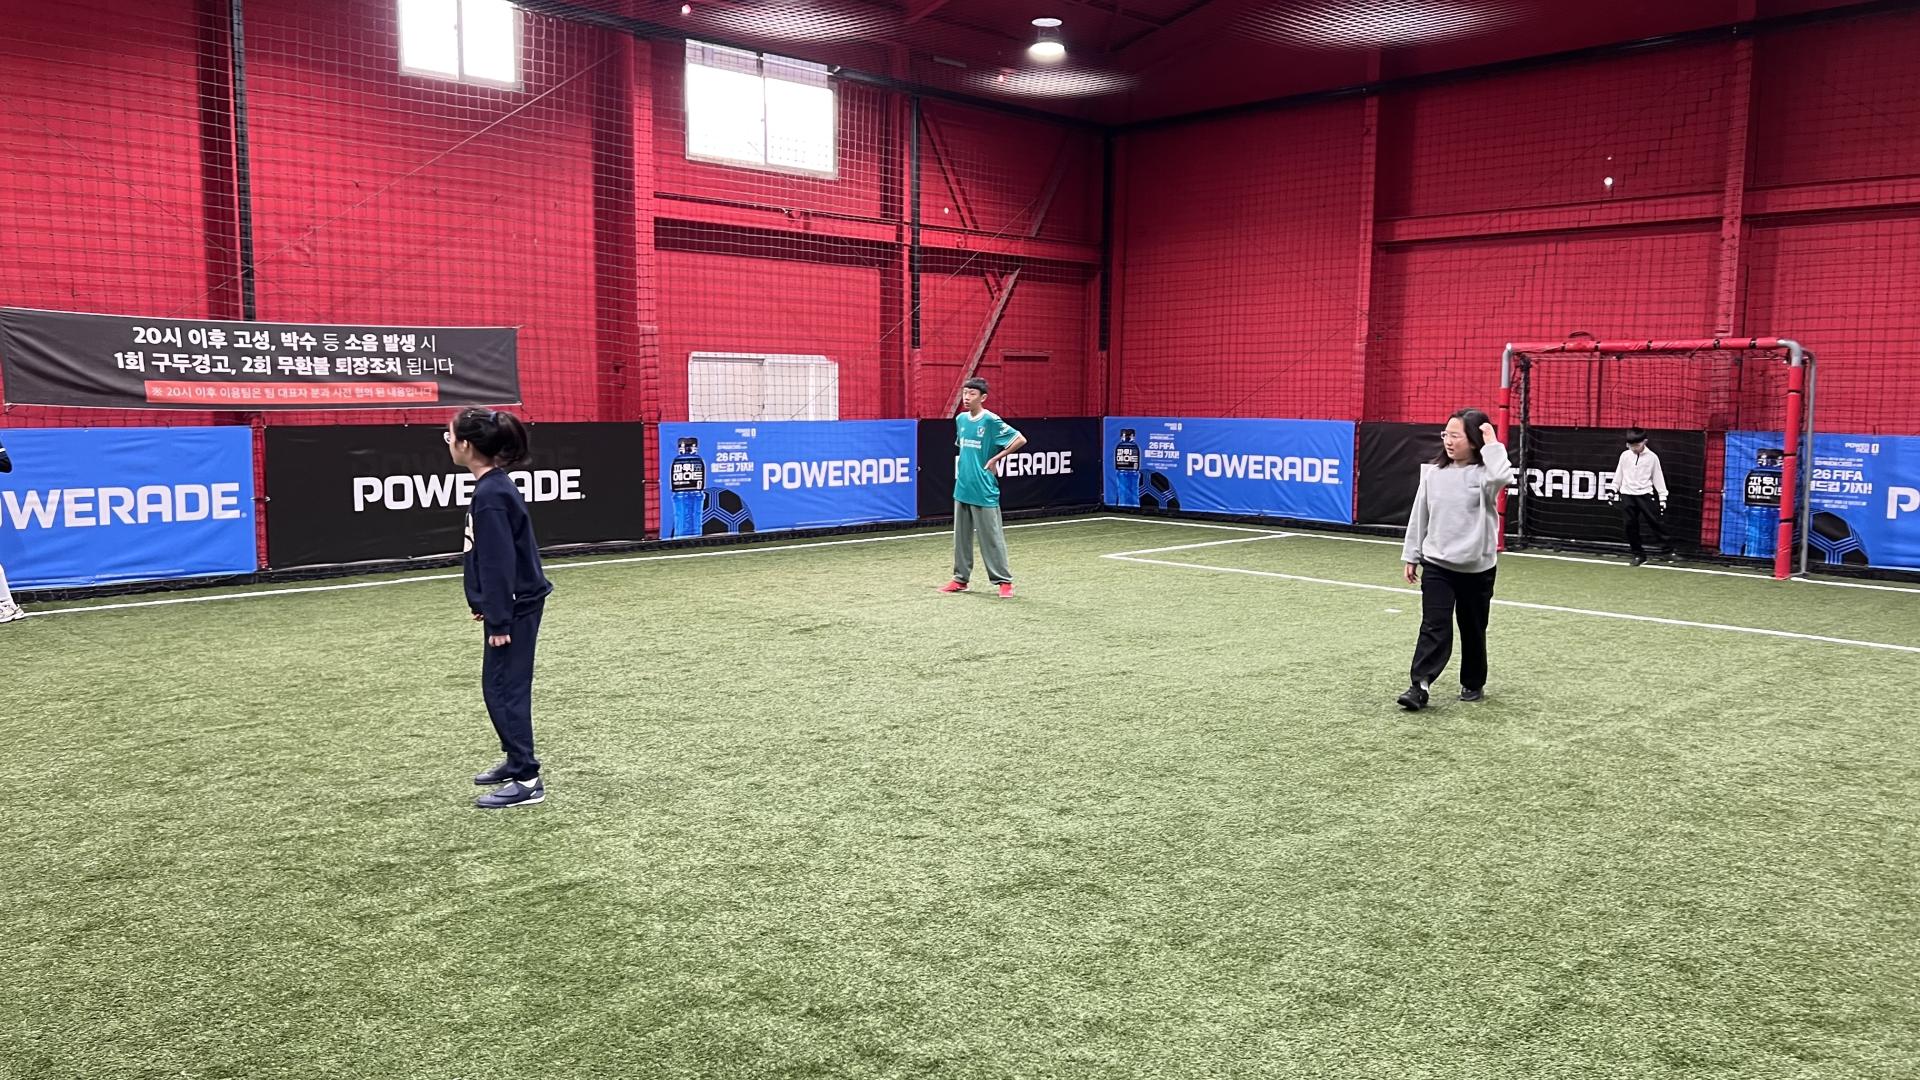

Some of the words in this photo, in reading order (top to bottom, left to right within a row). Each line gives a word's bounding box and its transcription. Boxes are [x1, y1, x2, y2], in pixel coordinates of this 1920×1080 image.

[132, 326, 183, 348] 20시
[188, 328, 228, 349] 이후
[233, 330, 277, 351] 고성,
[280, 332, 318, 352] 박수
[322, 333, 340, 351] 등
[344, 334, 379, 352] 소음
[382, 334, 416, 352] 발생
[420, 335, 436, 353] 시
[114, 351, 146, 373] 1회
[151, 353, 237, 375] 구두경고,
[241, 355, 272, 375] 2회
[277, 356, 331, 376] 무환불
[335, 356, 403, 376] 퇴장조치
[406, 357, 455, 375] 됩니다
[167, 387, 192, 398] 20시
[195, 387, 217, 398] 이후
[219, 388, 262, 399] 이용팀은
[277, 387, 308, 399] 대표자
[333, 387, 352, 399] 사전
[716, 452, 729, 462] 26
[729, 452, 748, 462] FIFA
[1186, 453, 1341, 485] POWERADE
[762, 457, 911, 491] POWERADE
[1812, 469, 1832, 480] 26
[1832, 469, 1864, 481] FIFA
[353, 468, 582, 512] POWEADE
[1841, 482, 1873, 494] 가자!
[0, 482, 241, 530] WERADE
